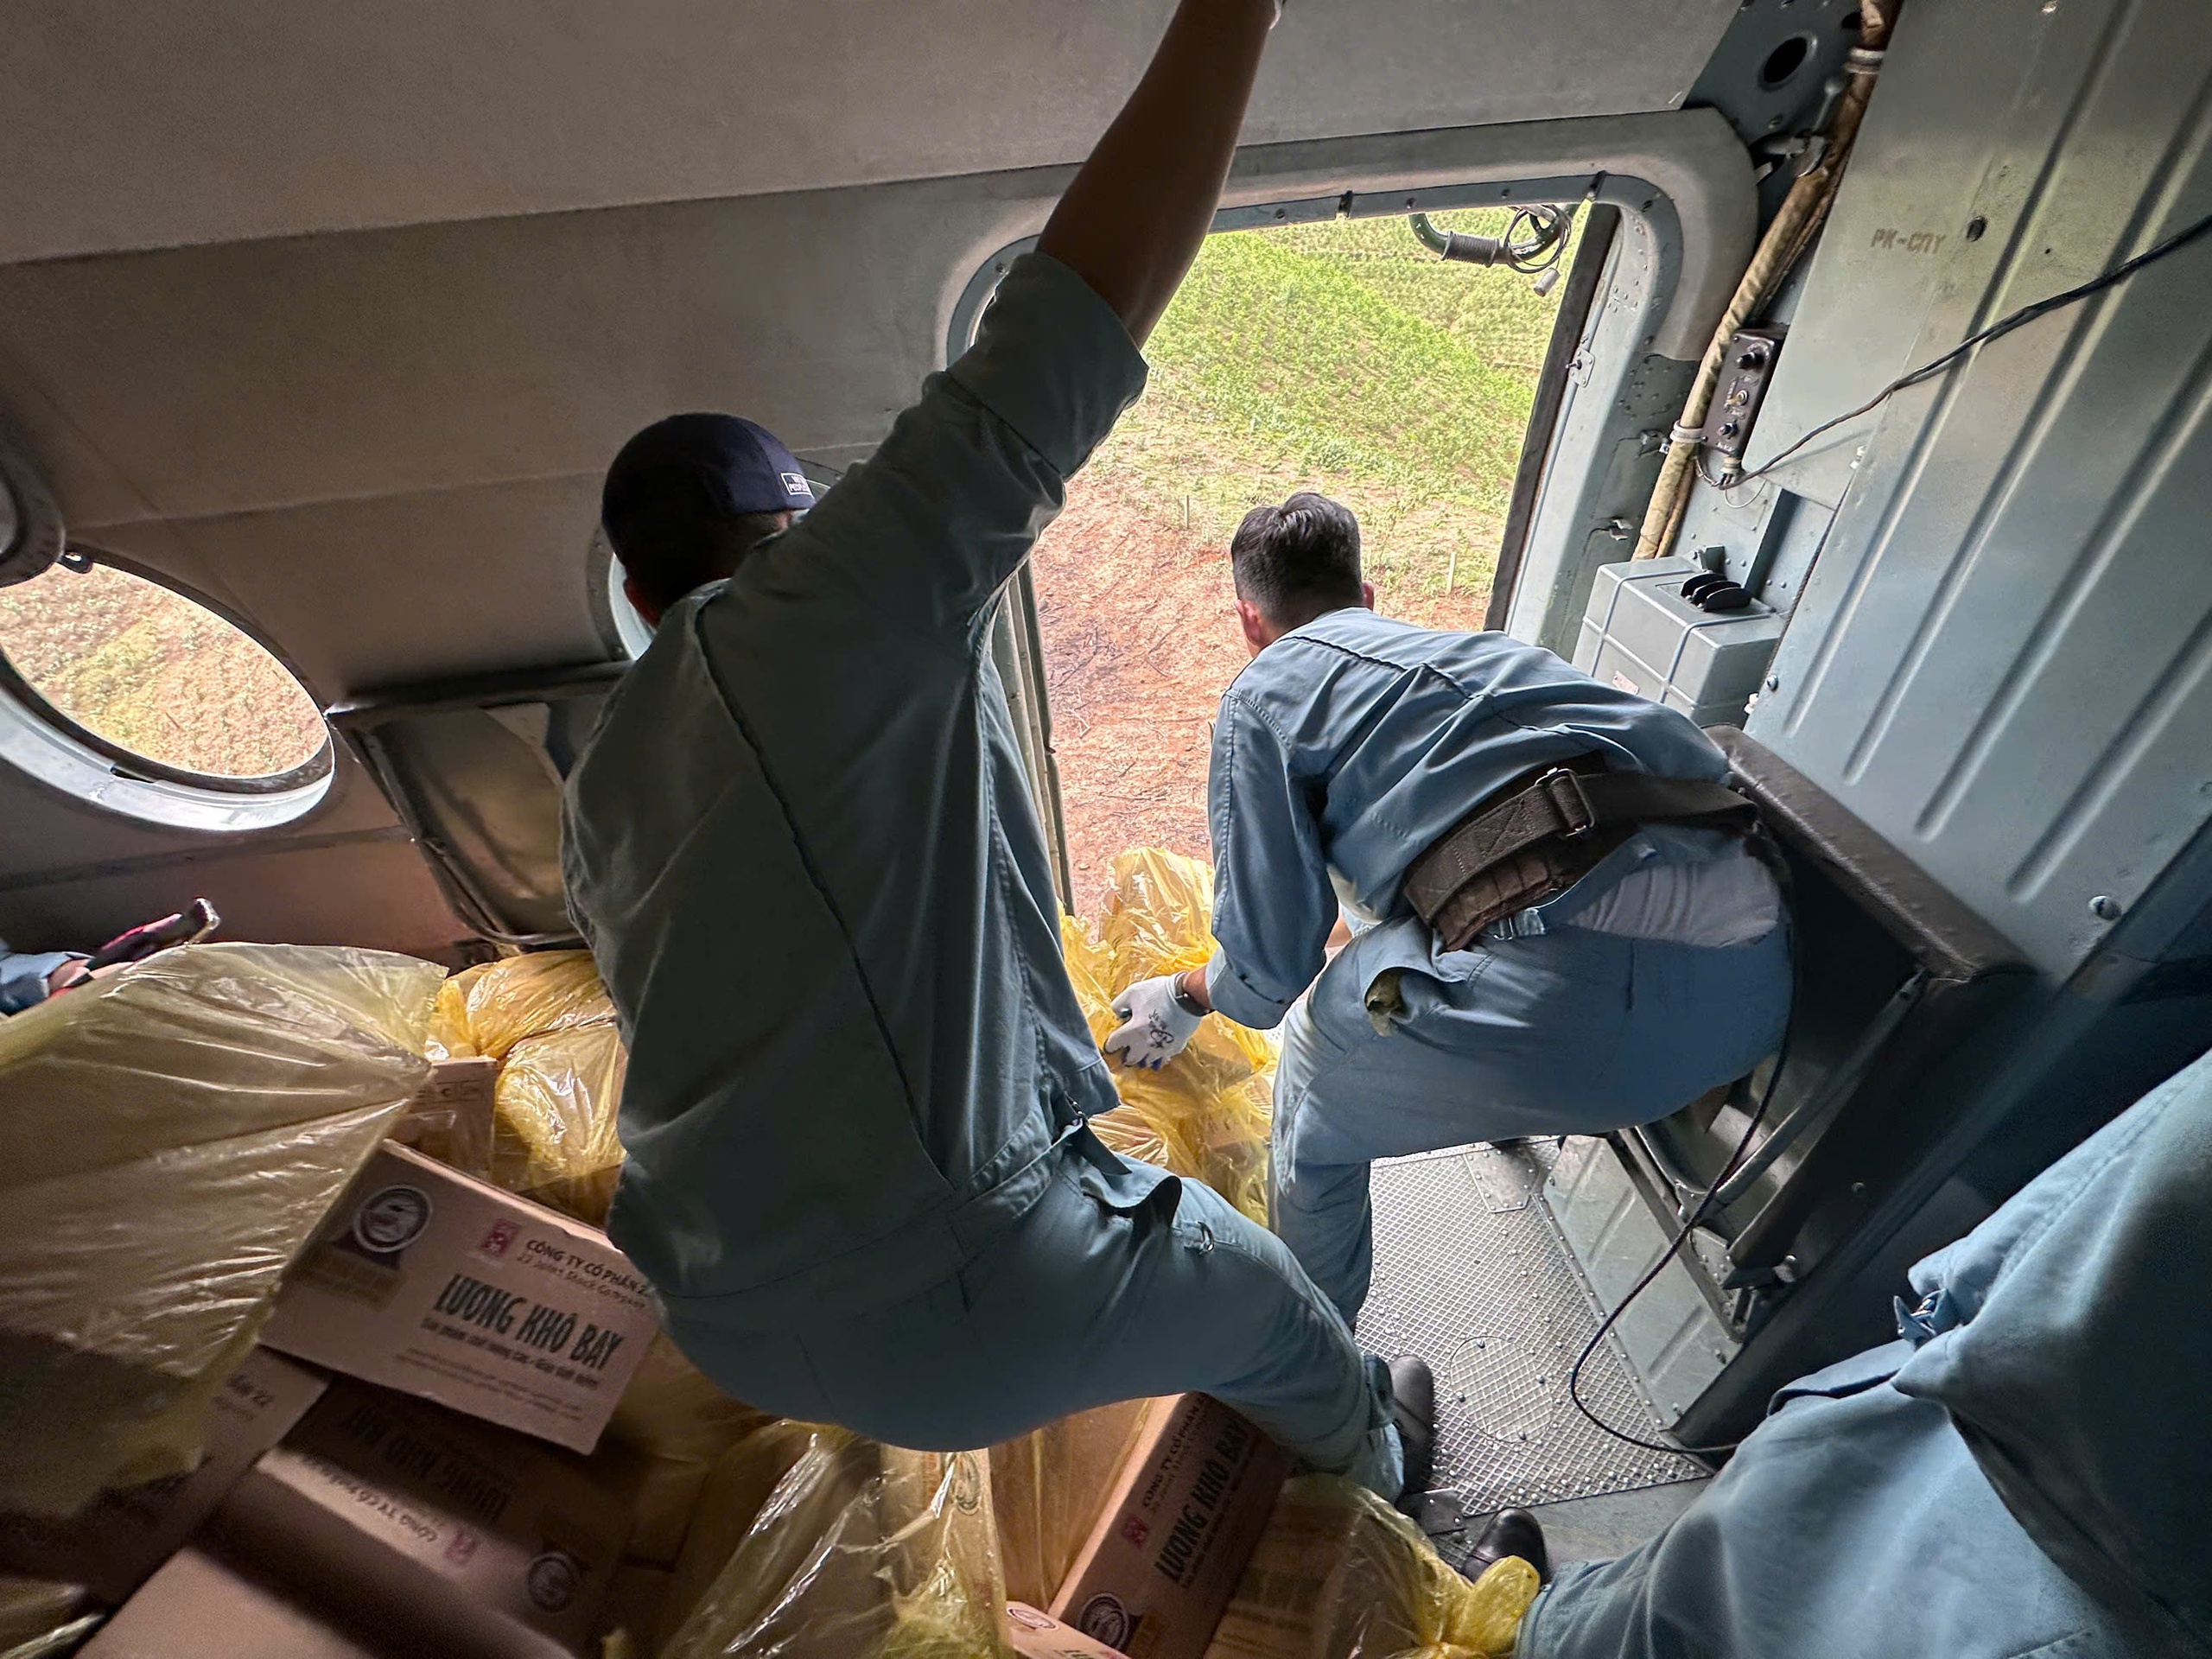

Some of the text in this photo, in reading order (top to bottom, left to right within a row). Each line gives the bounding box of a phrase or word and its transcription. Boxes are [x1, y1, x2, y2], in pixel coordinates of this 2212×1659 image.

[567, 1255, 585, 1268] TY
[516, 1304, 578, 1353] KHÔ
[569, 1324, 624, 1379] BAY
